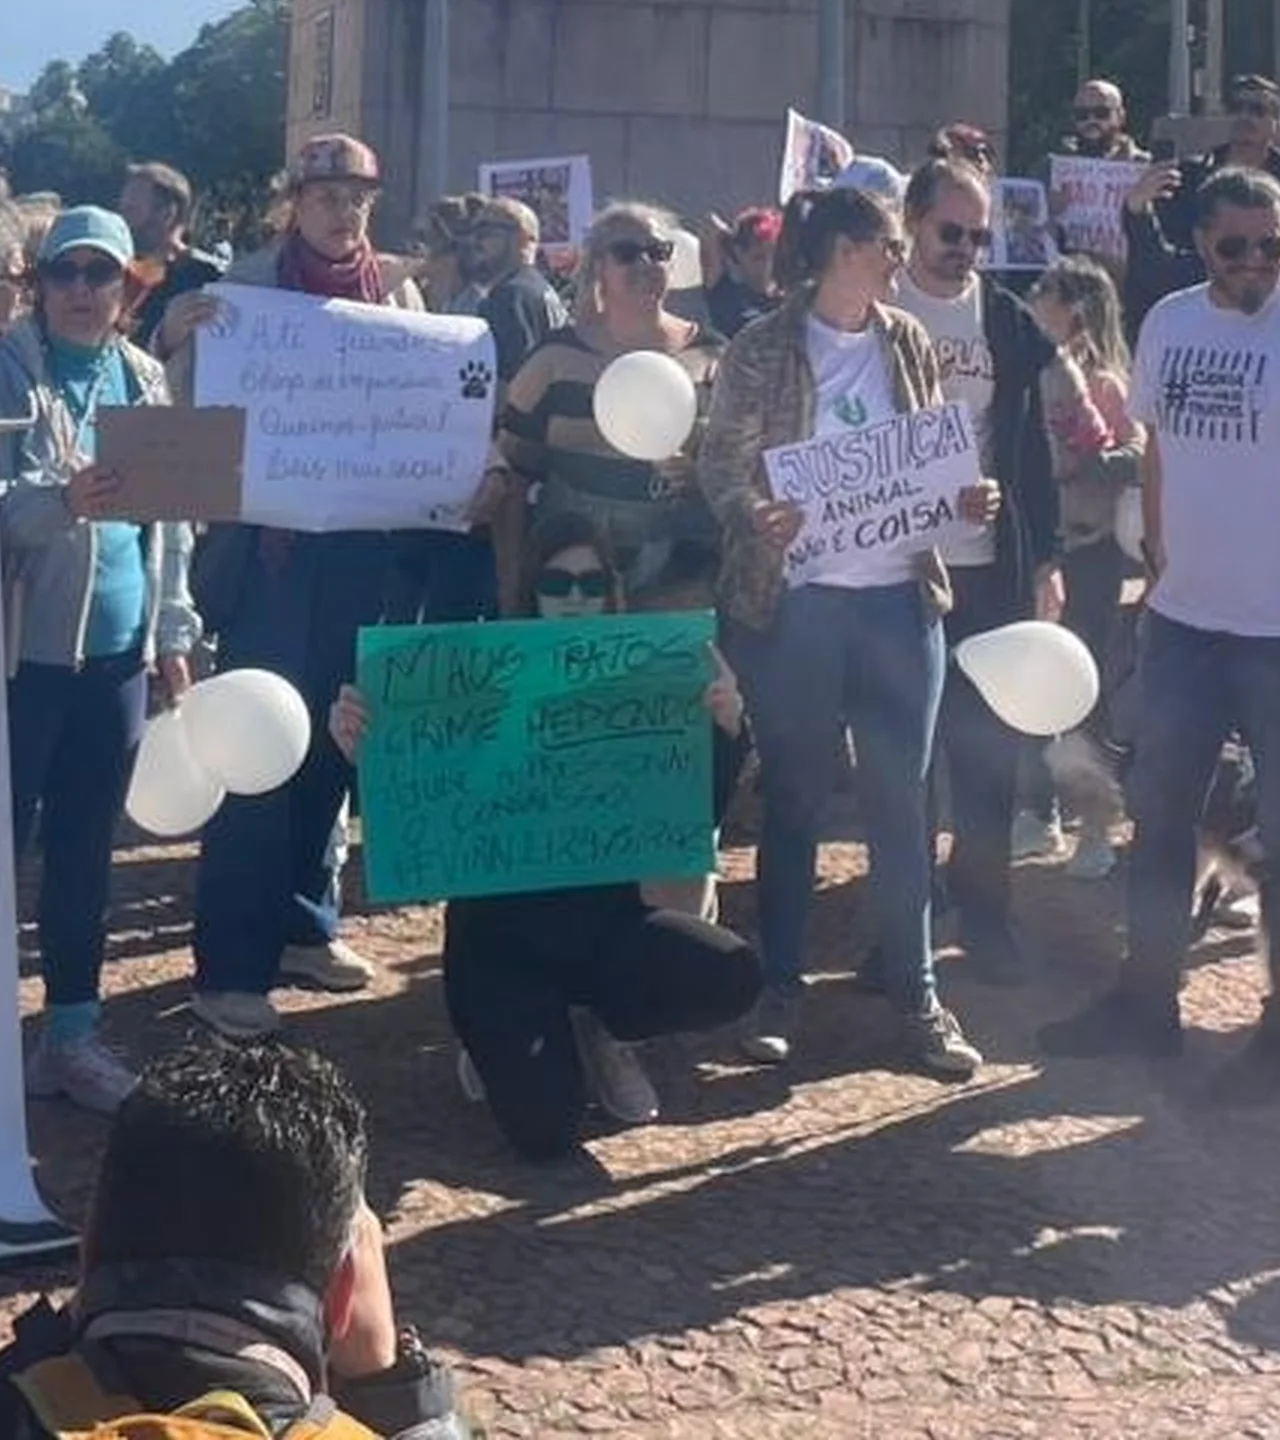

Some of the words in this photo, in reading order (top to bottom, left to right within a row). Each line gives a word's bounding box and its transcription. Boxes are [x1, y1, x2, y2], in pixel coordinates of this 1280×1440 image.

[777, 403, 970, 503] JUSTIÇA
[822, 477, 924, 523] ANIMAL
[854, 495, 955, 550] COISA
[382, 633, 524, 703] MAUS
